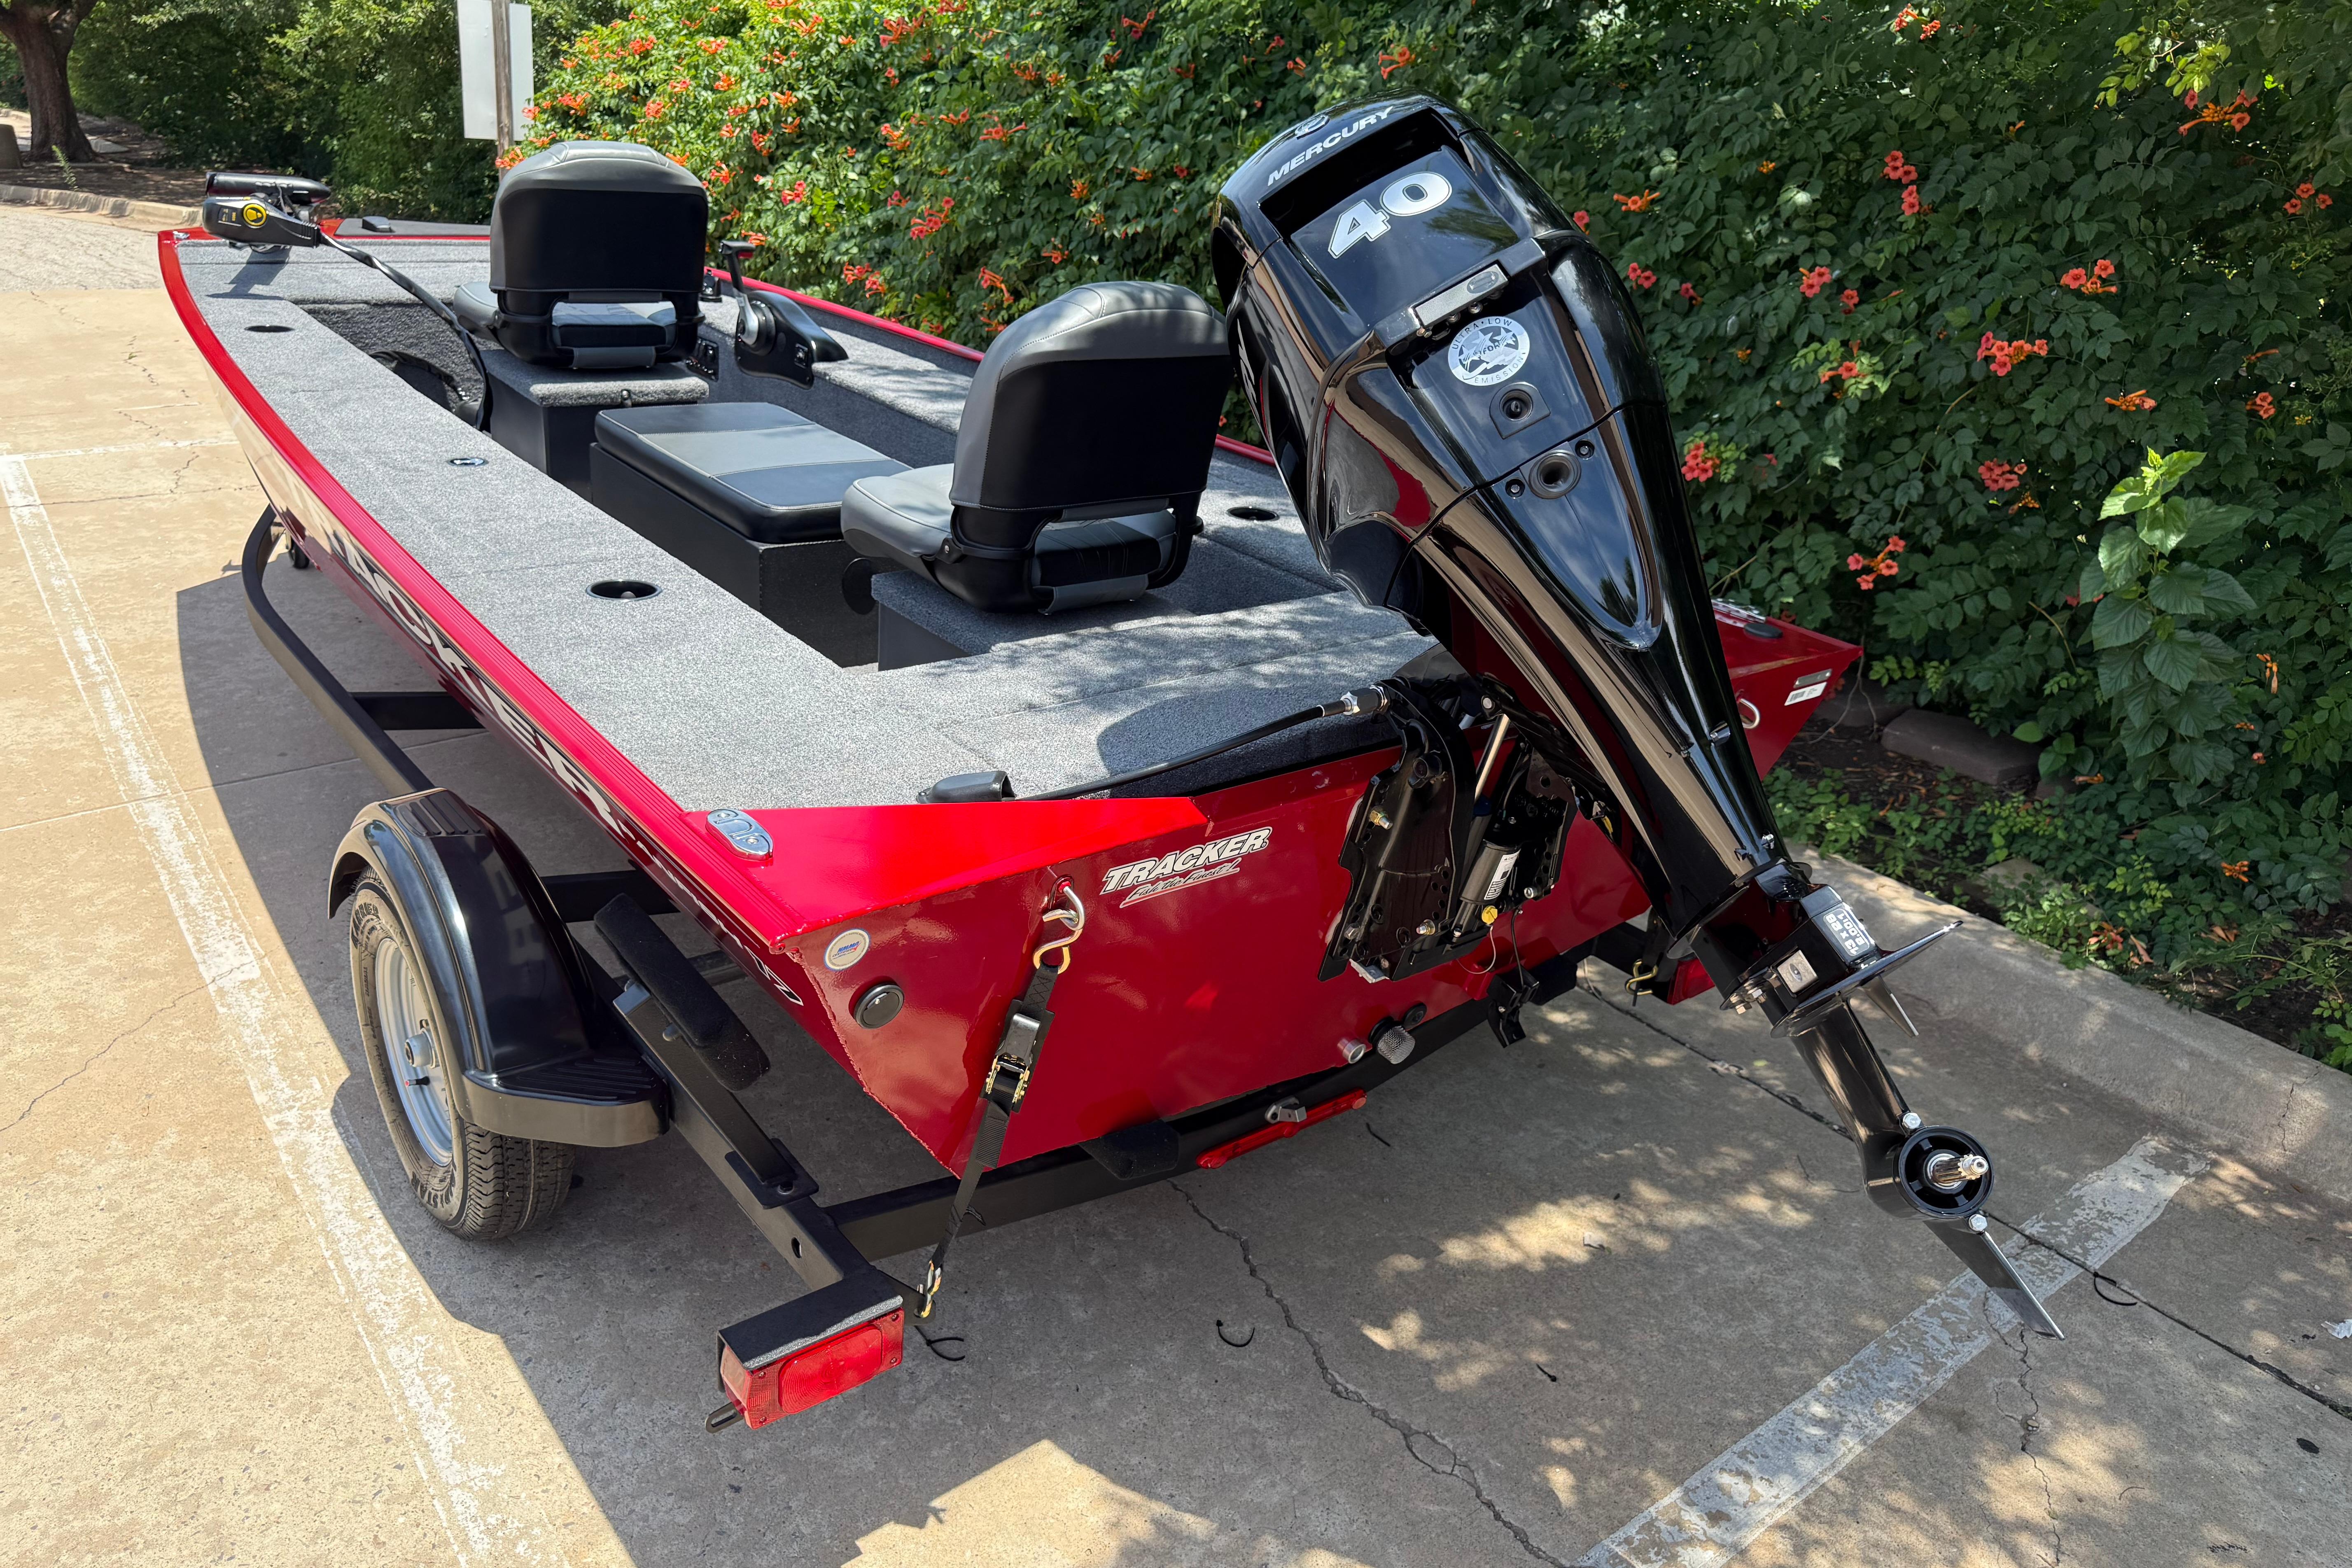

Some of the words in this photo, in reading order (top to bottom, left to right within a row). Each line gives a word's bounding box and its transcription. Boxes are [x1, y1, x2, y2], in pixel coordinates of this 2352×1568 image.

[1267, 105, 1394, 187] MERCURY
[1328, 171, 1453, 259] 40
[1451, 323, 1479, 350] ULTRA
[1488, 317, 1512, 327] LOW
[1102, 828, 1271, 894] TRACKER
[1129, 882, 1160, 900] Fish
[1160, 877, 1183, 891] the
[1844, 939, 1859, 955] 13
